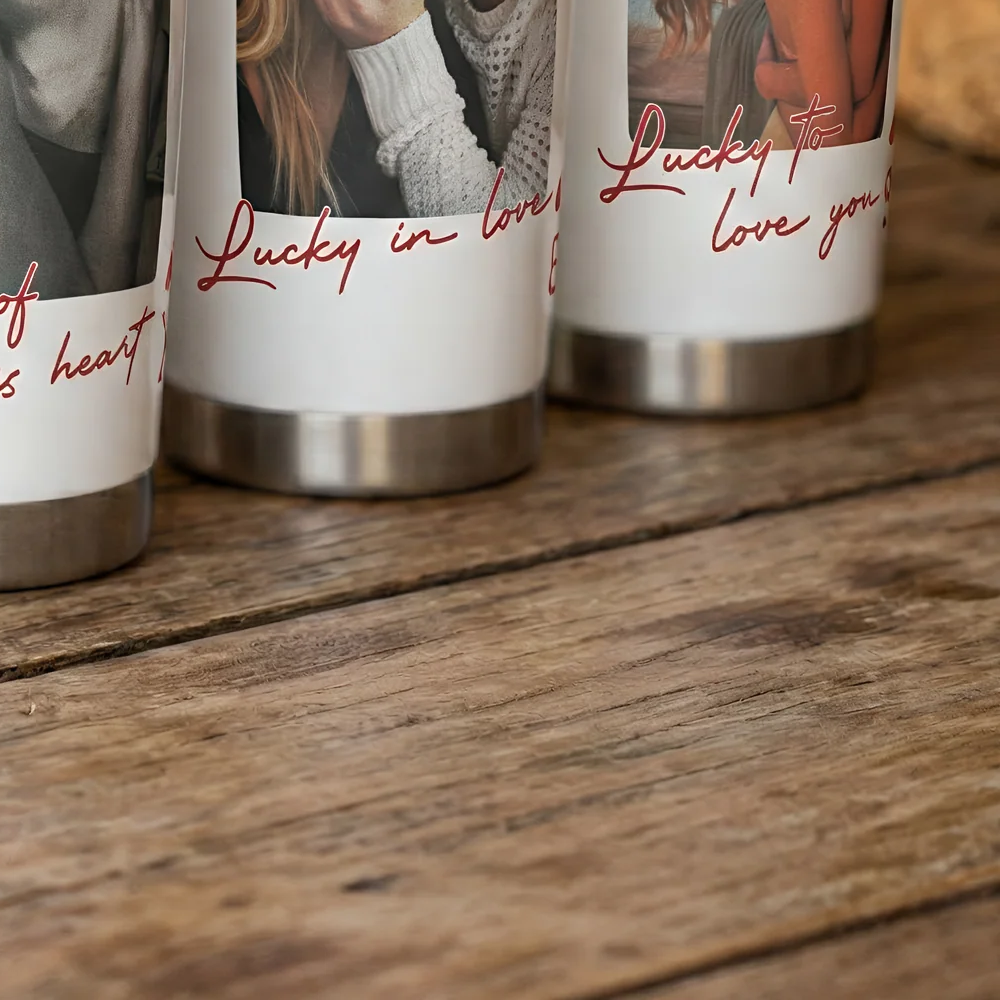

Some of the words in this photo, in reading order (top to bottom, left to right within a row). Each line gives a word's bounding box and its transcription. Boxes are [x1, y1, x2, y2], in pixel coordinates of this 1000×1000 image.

[597, 102, 774, 204] Lucky
[790, 93, 844, 184] to
[195, 198, 361, 295] Lucky
[390, 221, 458, 253] in
[481, 166, 553, 240] love
[711, 187, 811, 253] love
[817, 189, 880, 260] you
[50, 305, 156, 386] heart
